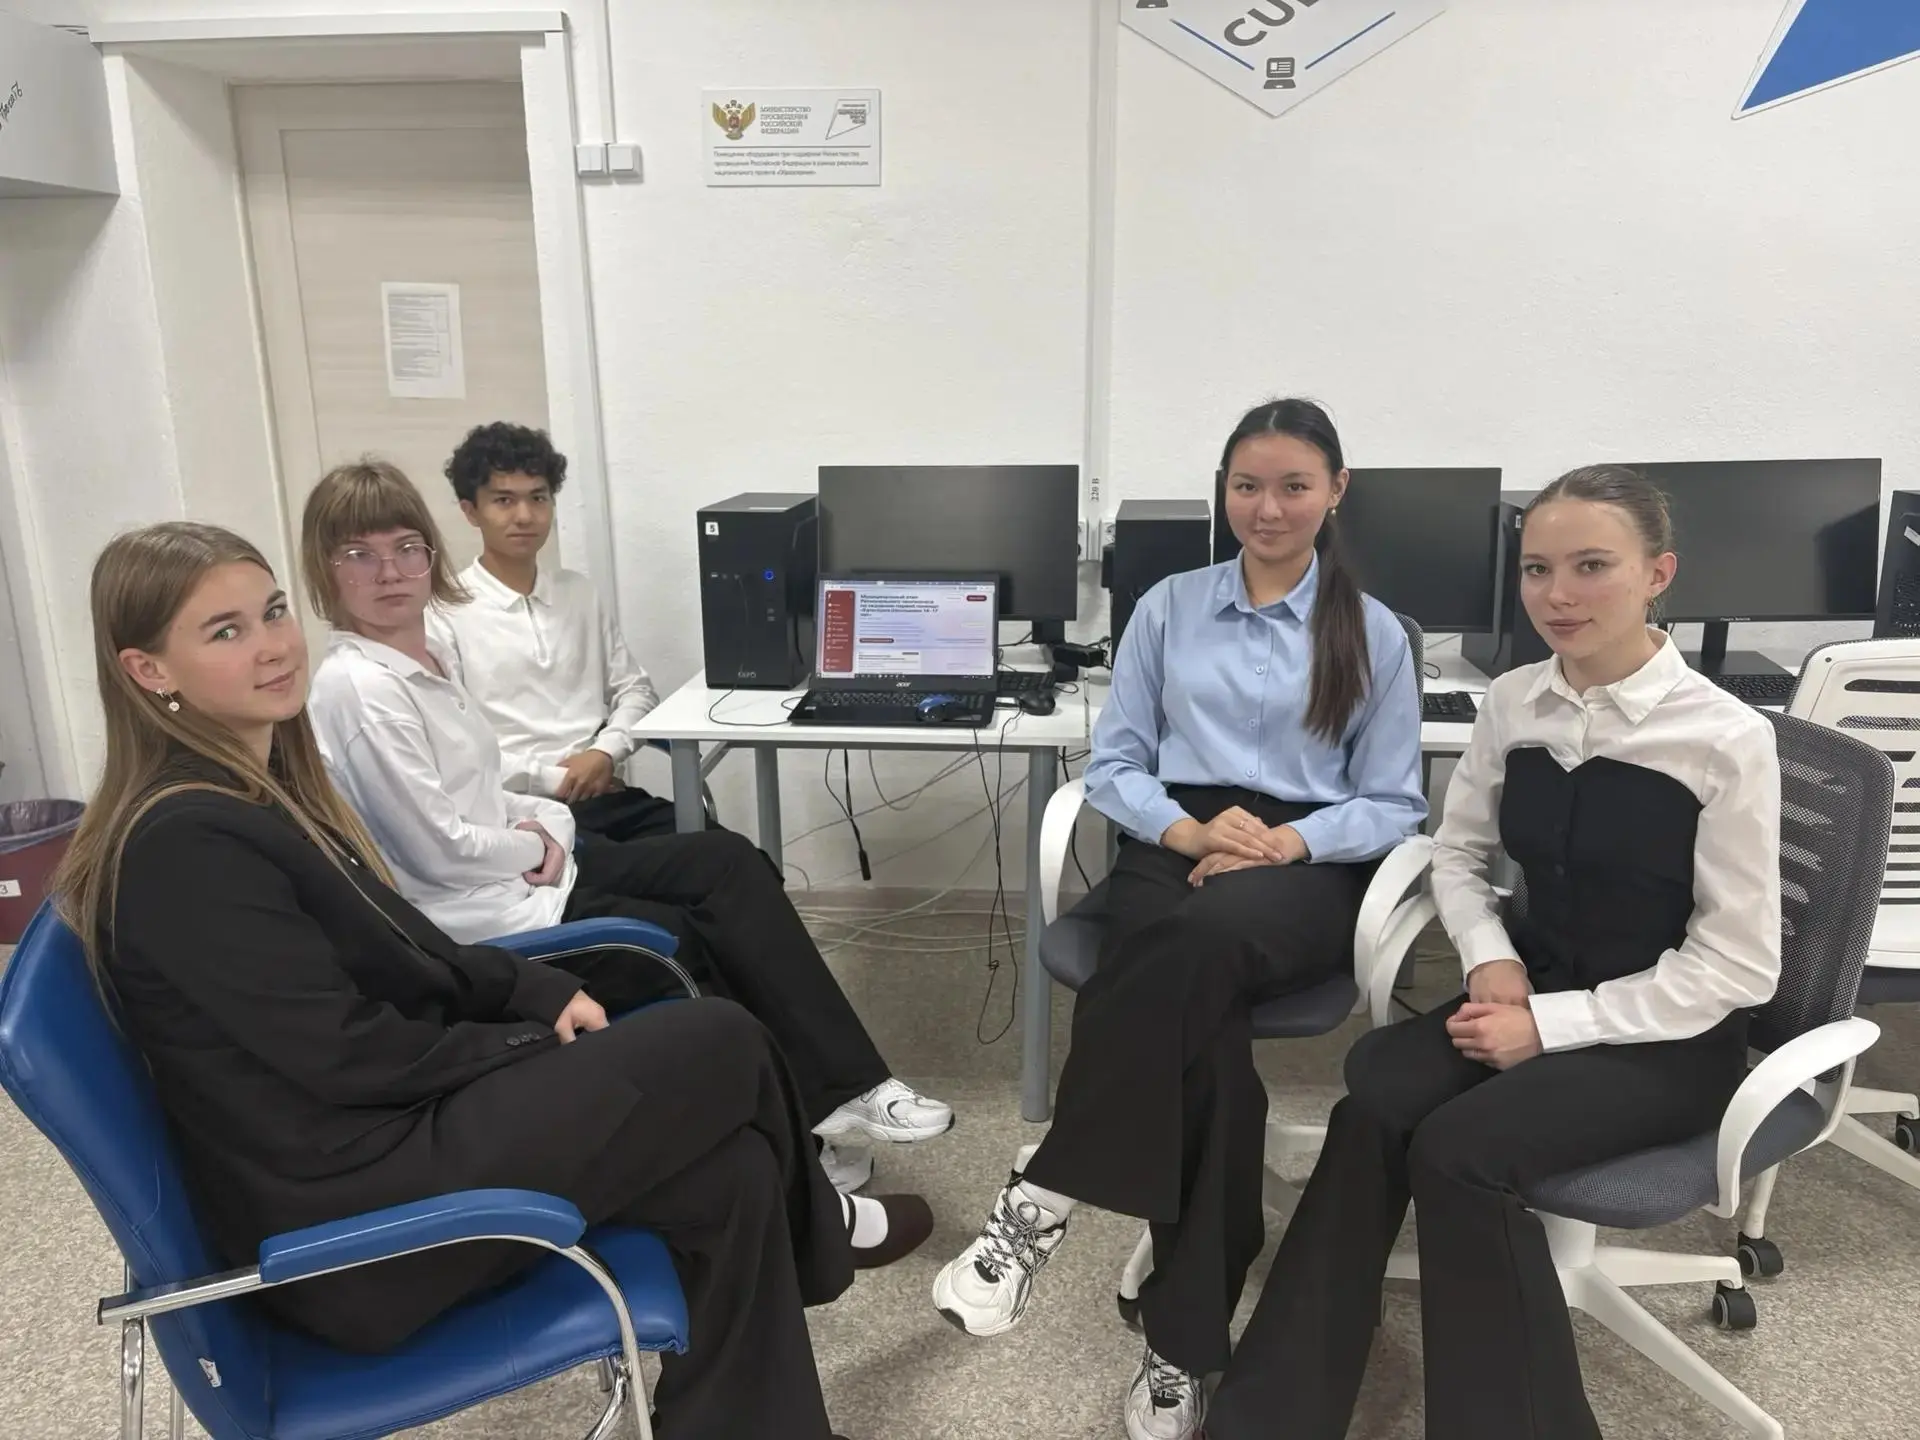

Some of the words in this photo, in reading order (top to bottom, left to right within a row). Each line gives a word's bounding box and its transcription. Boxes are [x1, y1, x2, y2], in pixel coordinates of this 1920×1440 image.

[1223, 0, 1319, 46] CU
[1091, 486, 1100, 502] 220
[709, 524, 716, 533] 5
